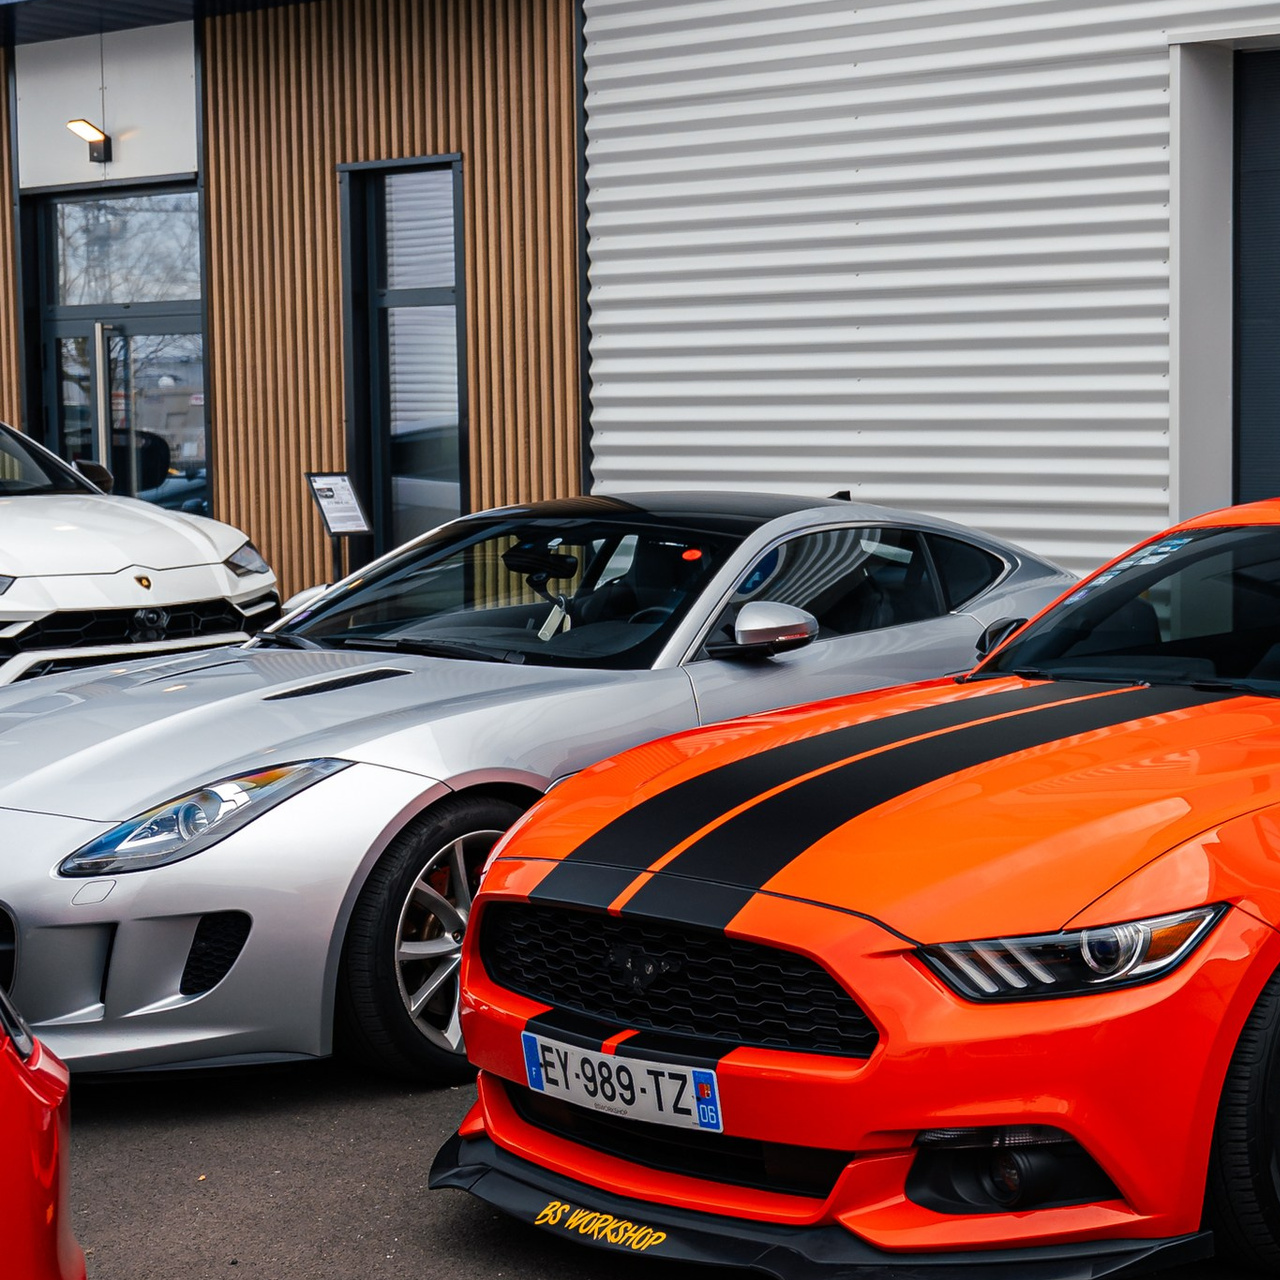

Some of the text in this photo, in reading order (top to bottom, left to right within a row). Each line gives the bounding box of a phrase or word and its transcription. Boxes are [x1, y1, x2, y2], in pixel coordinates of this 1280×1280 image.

[699, 1104, 717, 1124] 06
[534, 1200, 668, 1252] BS WORKSHOP
